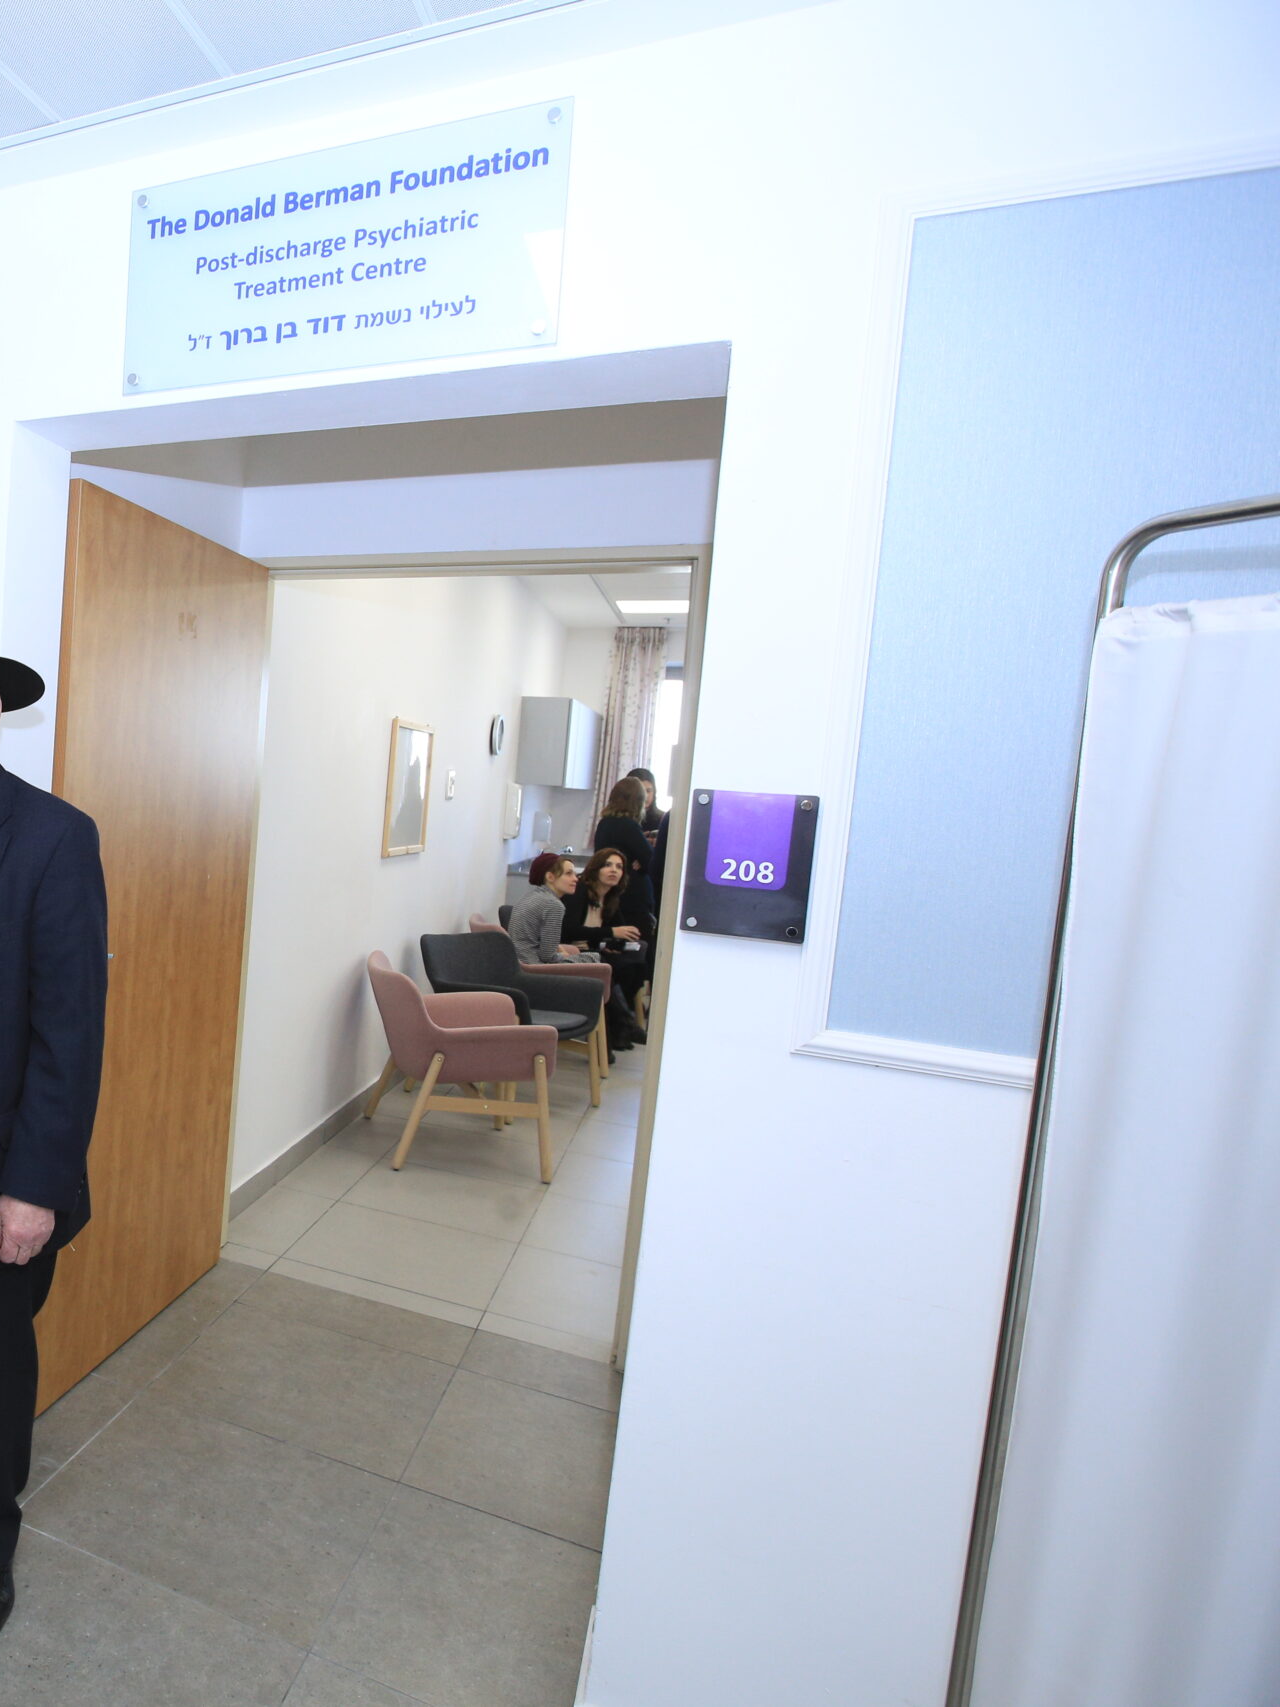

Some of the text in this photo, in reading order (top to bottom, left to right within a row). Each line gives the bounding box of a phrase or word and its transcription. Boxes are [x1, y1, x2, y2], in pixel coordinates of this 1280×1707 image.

[146, 145, 551, 240] The Donald Berman Foundation
[195, 209, 480, 275] Post-discharge Psychiatric
[233, 256, 428, 301] Treatment Centre
[353, 307, 413, 330] נשמת
[419, 294, 477, 321] לעילוי
[275, 321, 299, 344] בן
[306, 314, 347, 335] דוד
[219, 325, 269, 351] ברוך
[720, 858, 775, 884] 208
